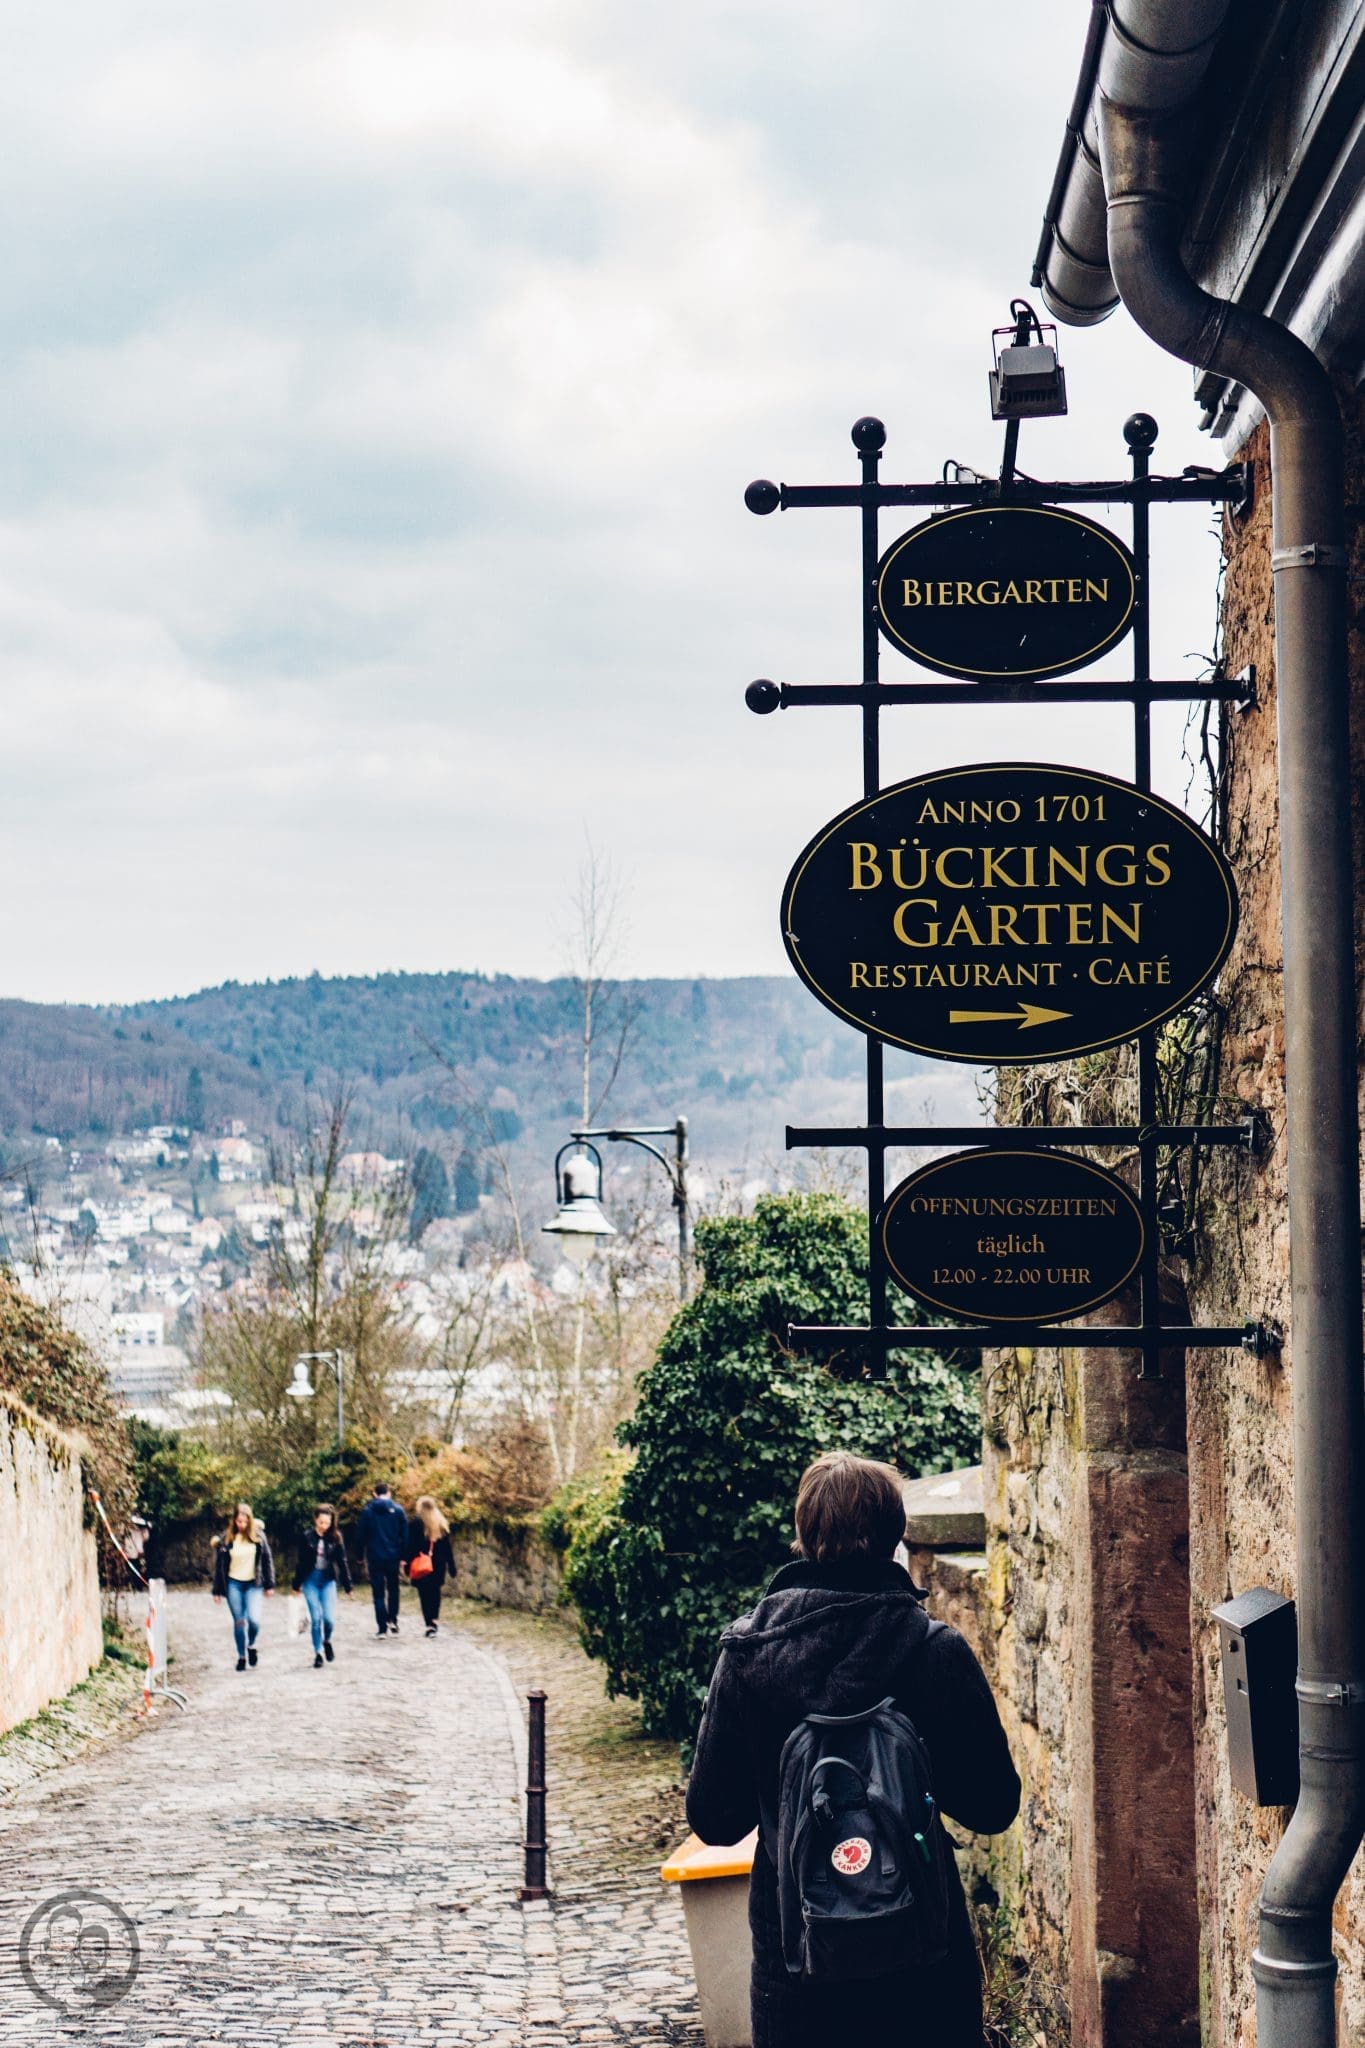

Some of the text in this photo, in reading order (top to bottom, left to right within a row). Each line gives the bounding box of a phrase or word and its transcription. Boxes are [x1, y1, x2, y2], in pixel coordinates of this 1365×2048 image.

[901, 578, 1109, 607] BIERGARTEN
[915, 795, 1108, 824] ANNO 1701
[847, 838, 1171, 890] BÜCKINGS
[893, 898, 1143, 948] GARTEN
[849, 962, 1062, 988] RESTAURANT
[1088, 954, 1171, 985] CAFÉ
[976, 1233, 1046, 1258] täglich
[932, 1268, 976, 1284] 12.00
[993, 1268, 1041, 1284] 22.00
[1046, 1268, 1092, 1284] UHR
